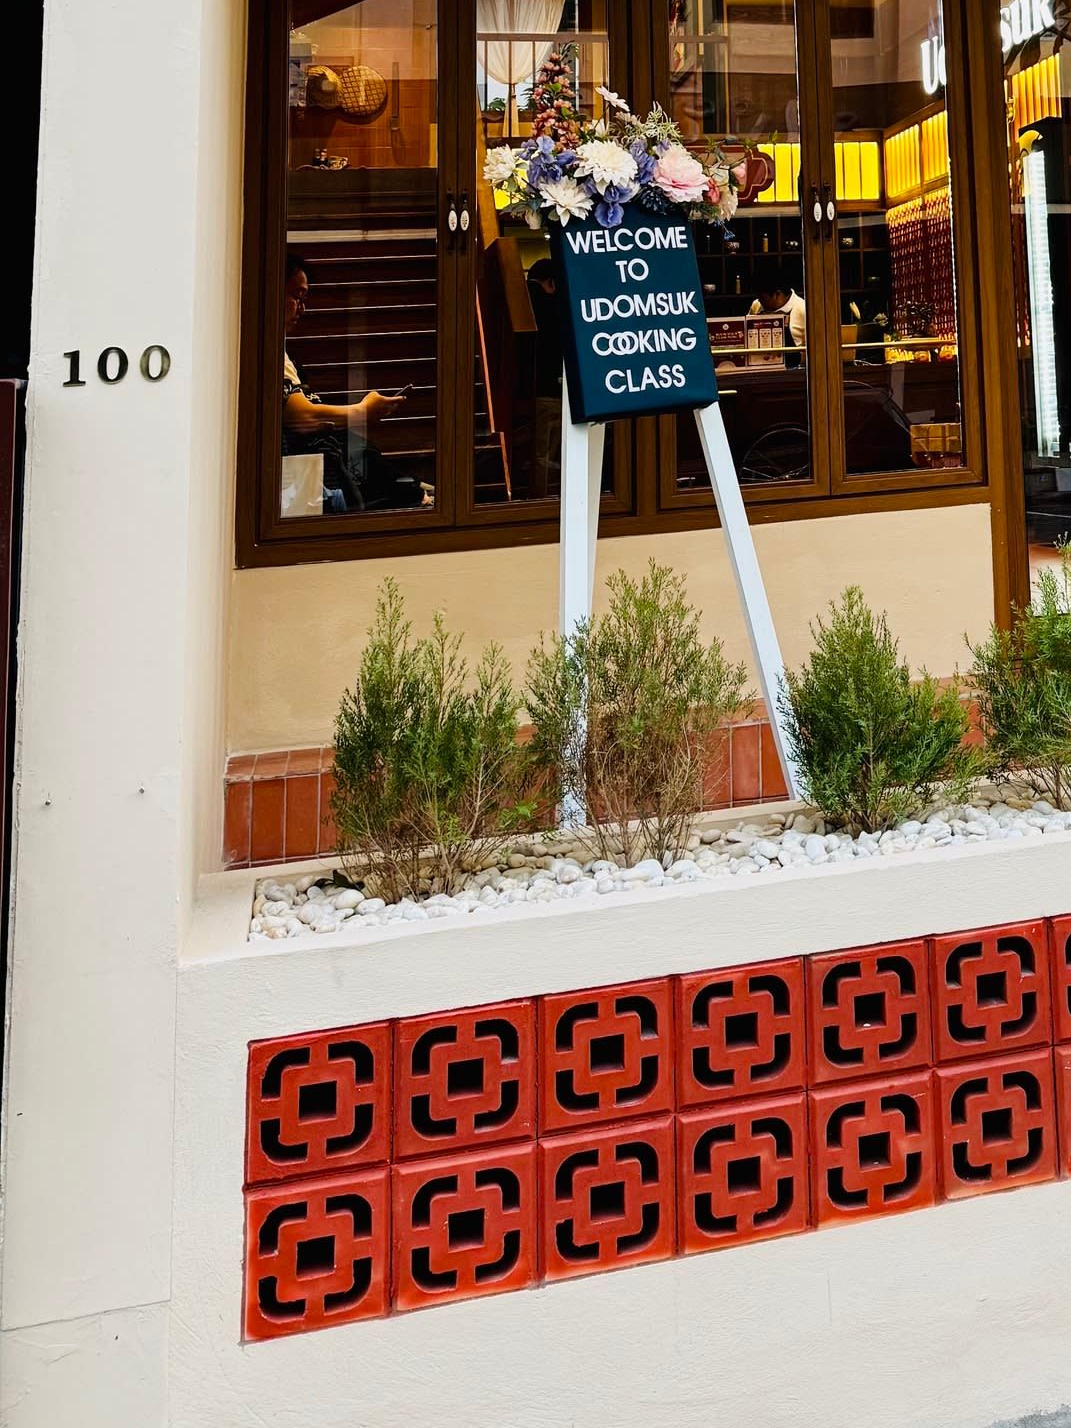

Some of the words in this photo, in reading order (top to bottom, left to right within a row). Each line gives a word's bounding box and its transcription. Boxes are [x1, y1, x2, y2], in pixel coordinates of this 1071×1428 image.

[566, 226, 688, 254] WELCOME
[615, 258, 649, 283] TO
[581, 291, 698, 322] UDOMSUK
[592, 328, 697, 356] COOKING
[63, 345, 171, 387] 100
[605, 364, 686, 394] CLASS
